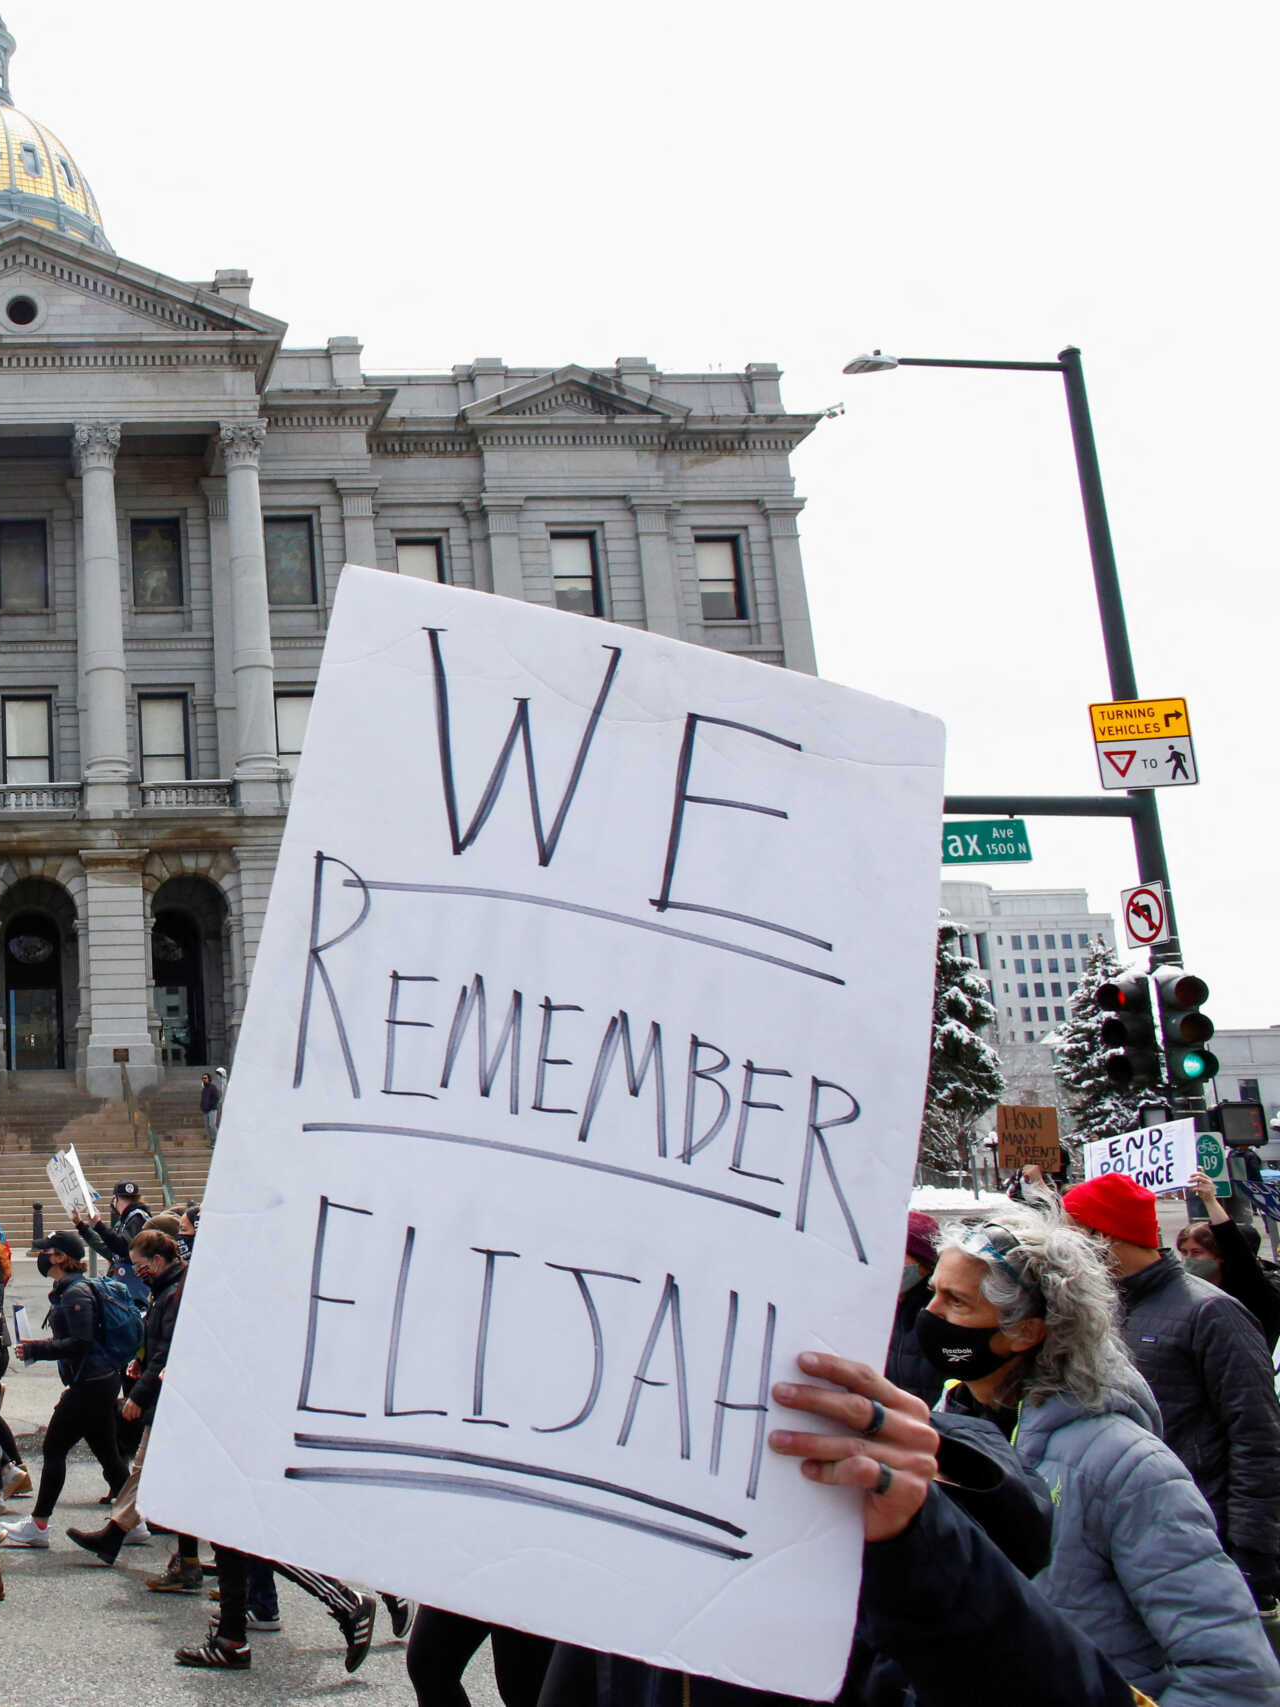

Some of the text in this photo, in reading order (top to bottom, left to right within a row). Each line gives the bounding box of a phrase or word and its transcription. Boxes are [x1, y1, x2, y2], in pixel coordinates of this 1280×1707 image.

[1100, 707, 1155, 721] TURNING
[1099, 722, 1161, 737] VEHICLES
[1142, 758, 1158, 769] TO
[422, 626, 833, 952] WE
[940, 833, 983, 857] ax
[992, 827, 1014, 839] Ave
[986, 842, 1027, 856] 1500 N
[292, 850, 869, 1265] REMEMBER
[1108, 1128, 1163, 1158] END
[1100, 1141, 1174, 1176] POLICE
[1203, 1155, 1218, 1171] D9
[1134, 1162, 1174, 1188] ENCE
[297, 1195, 777, 1500] ELIJAH
